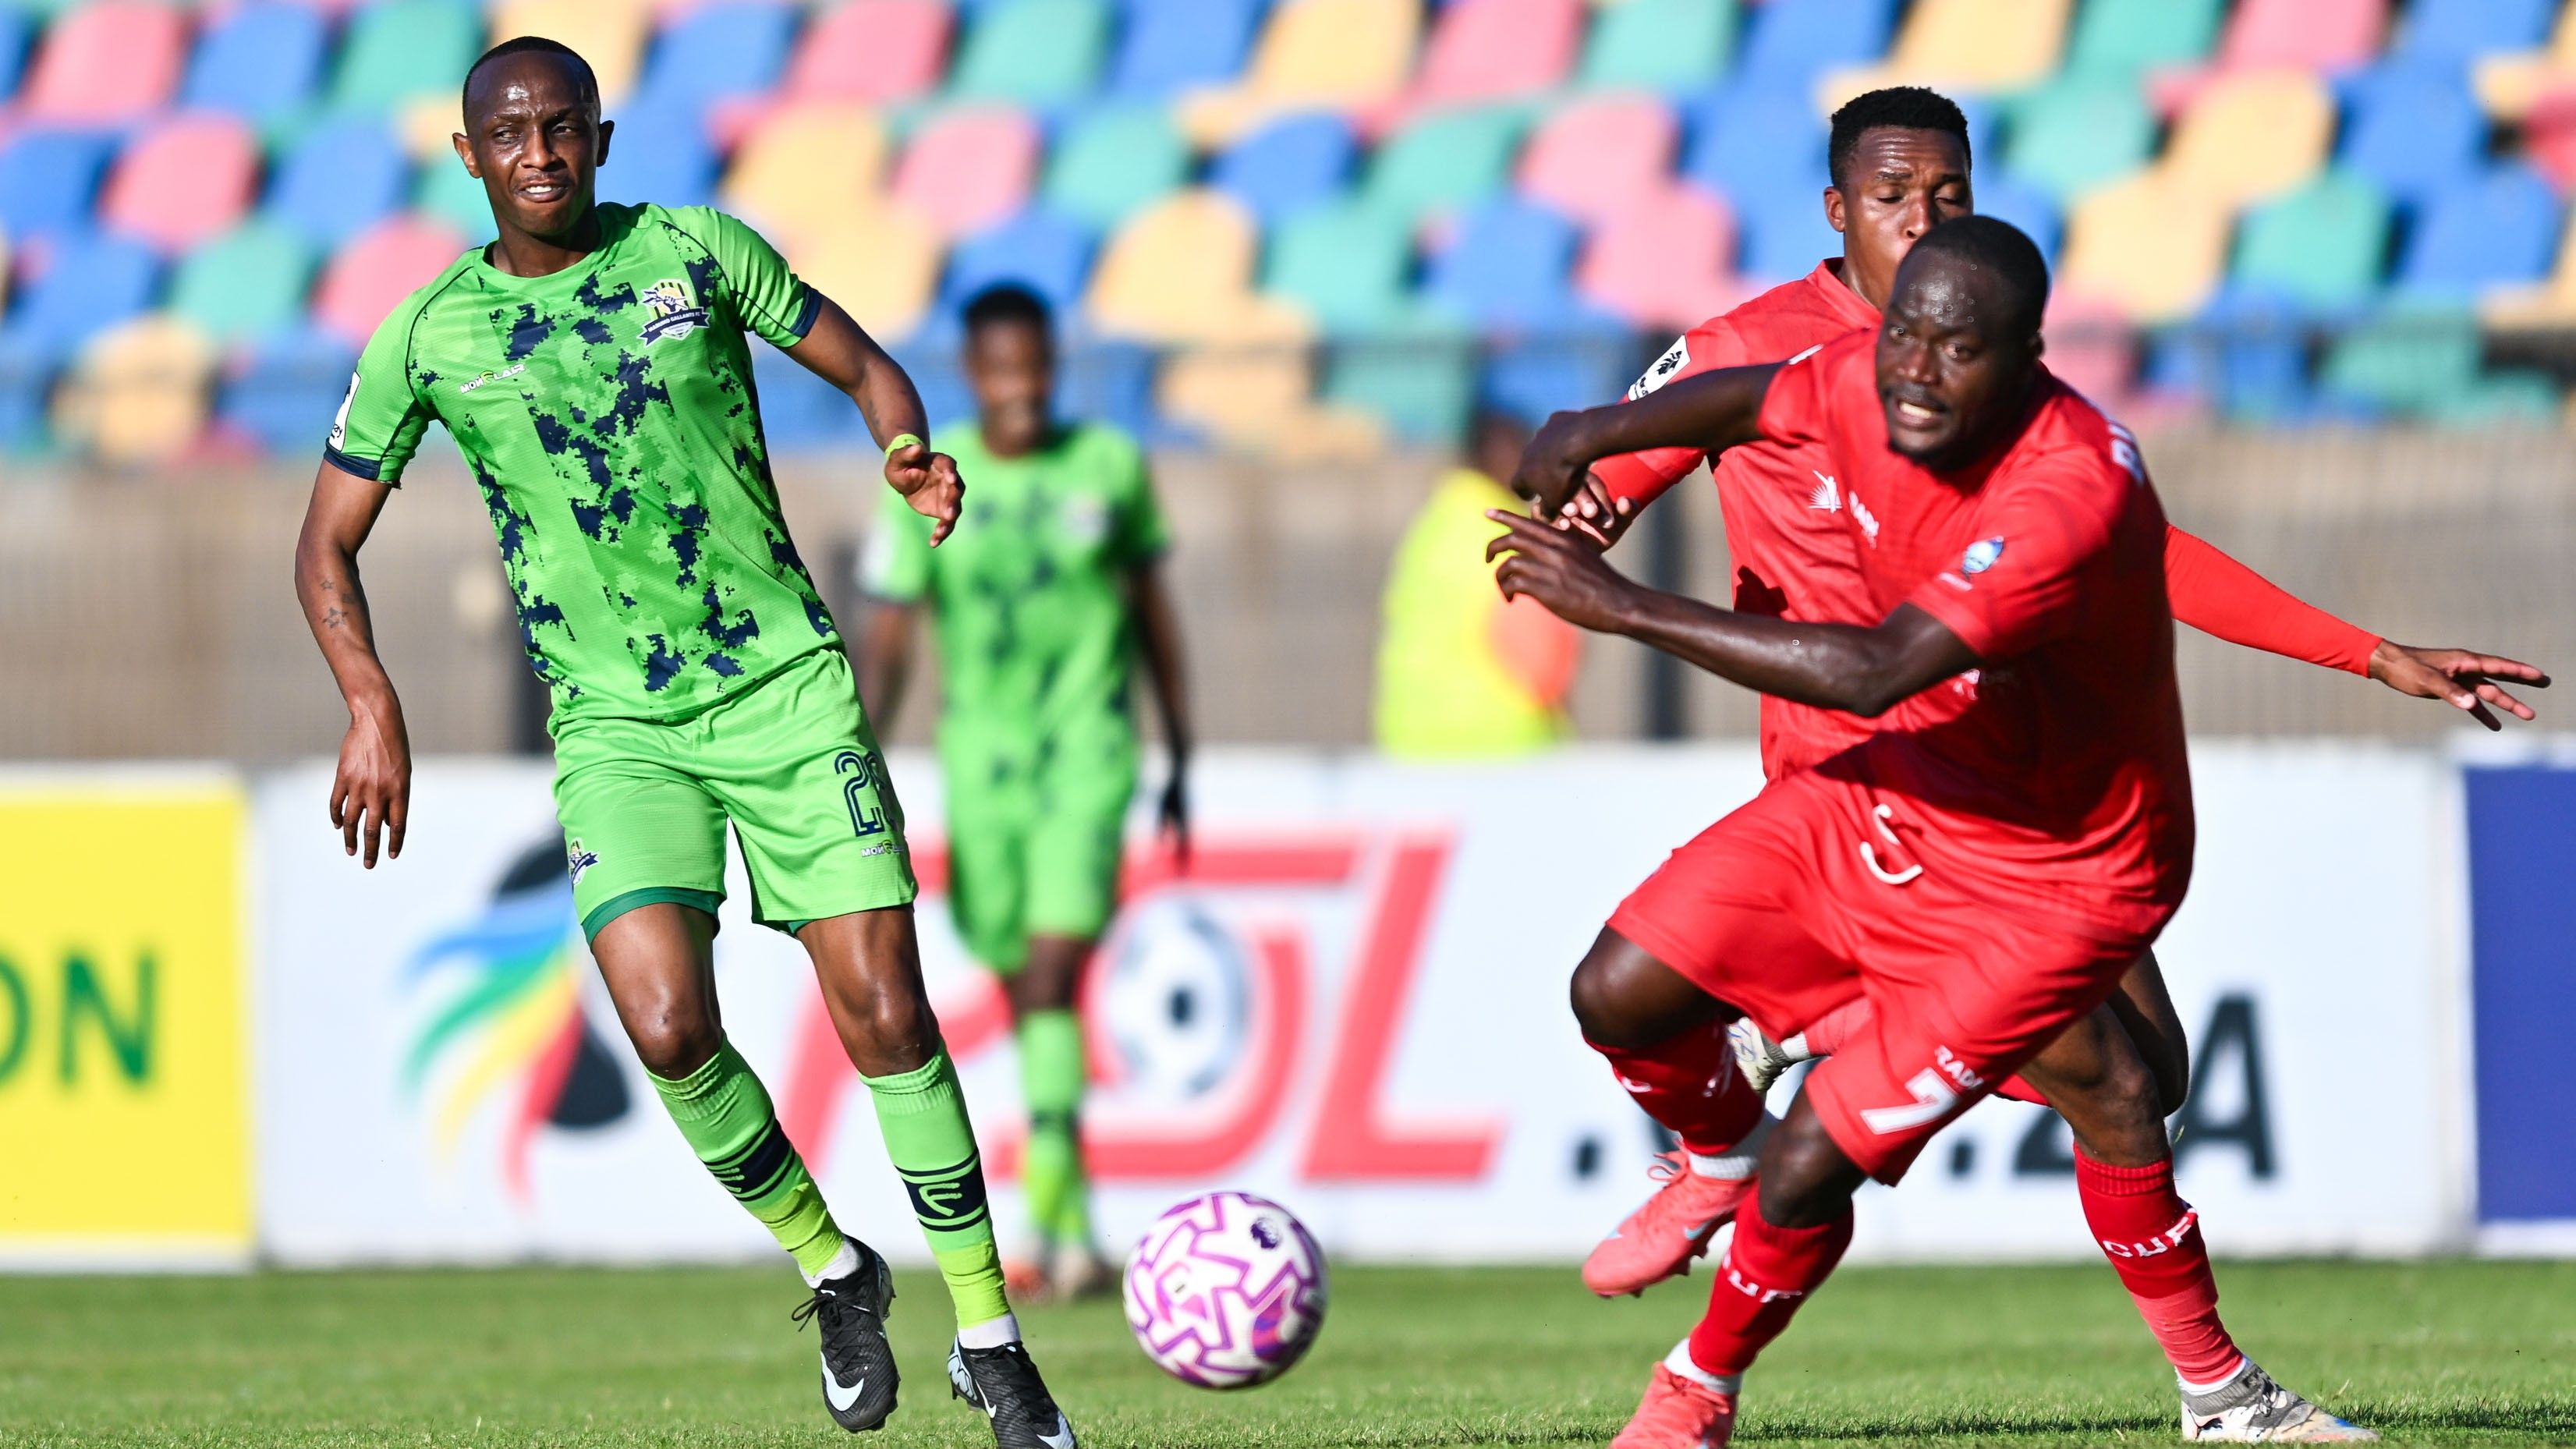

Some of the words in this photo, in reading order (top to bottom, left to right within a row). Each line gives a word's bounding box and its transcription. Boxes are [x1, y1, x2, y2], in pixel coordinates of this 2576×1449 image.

[778, 834, 1505, 1181] PSL
[1859, 1066, 1961, 1135] 7
[2103, 1207, 2198, 1258] CUF
